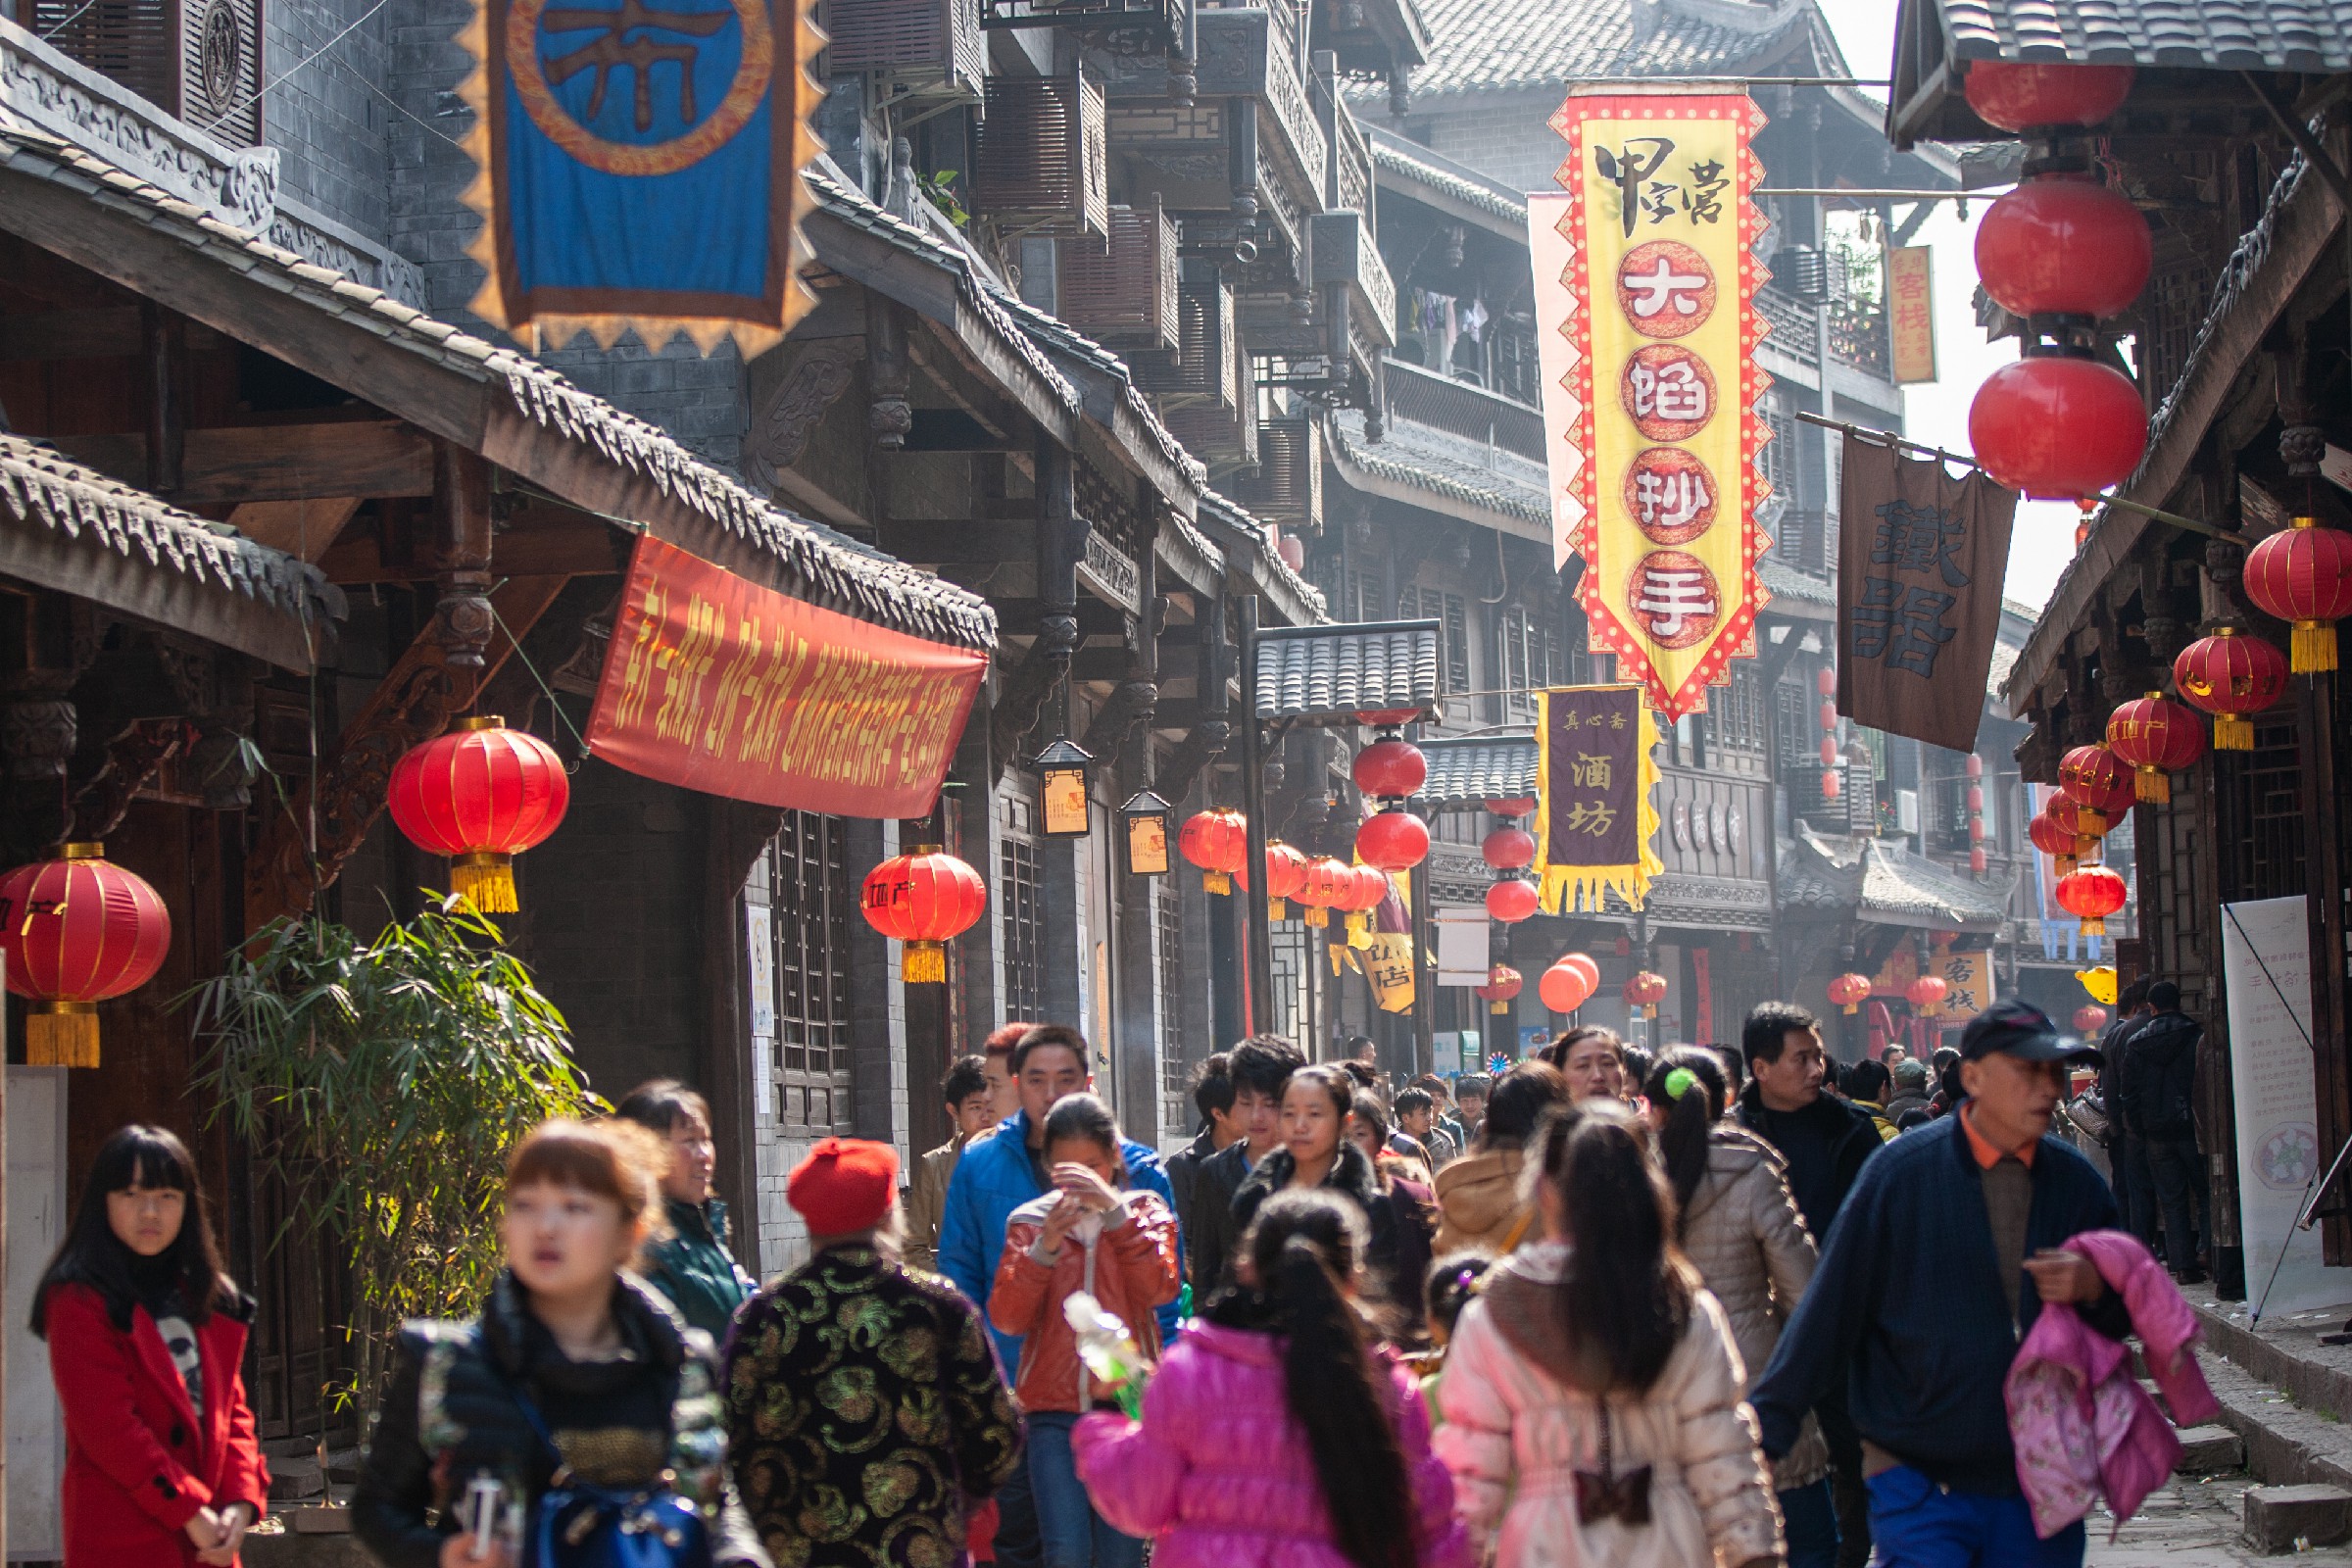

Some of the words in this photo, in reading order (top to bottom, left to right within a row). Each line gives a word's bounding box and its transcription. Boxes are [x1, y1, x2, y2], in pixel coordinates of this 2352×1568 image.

[1895, 271, 1929, 332] 客栈
[1563, 710, 1628, 731] 真心斋
[1566, 751, 1617, 837] 酒坊
[860, 880, 916, 909] 地产
[1942, 957, 1980, 1013] 客栈
